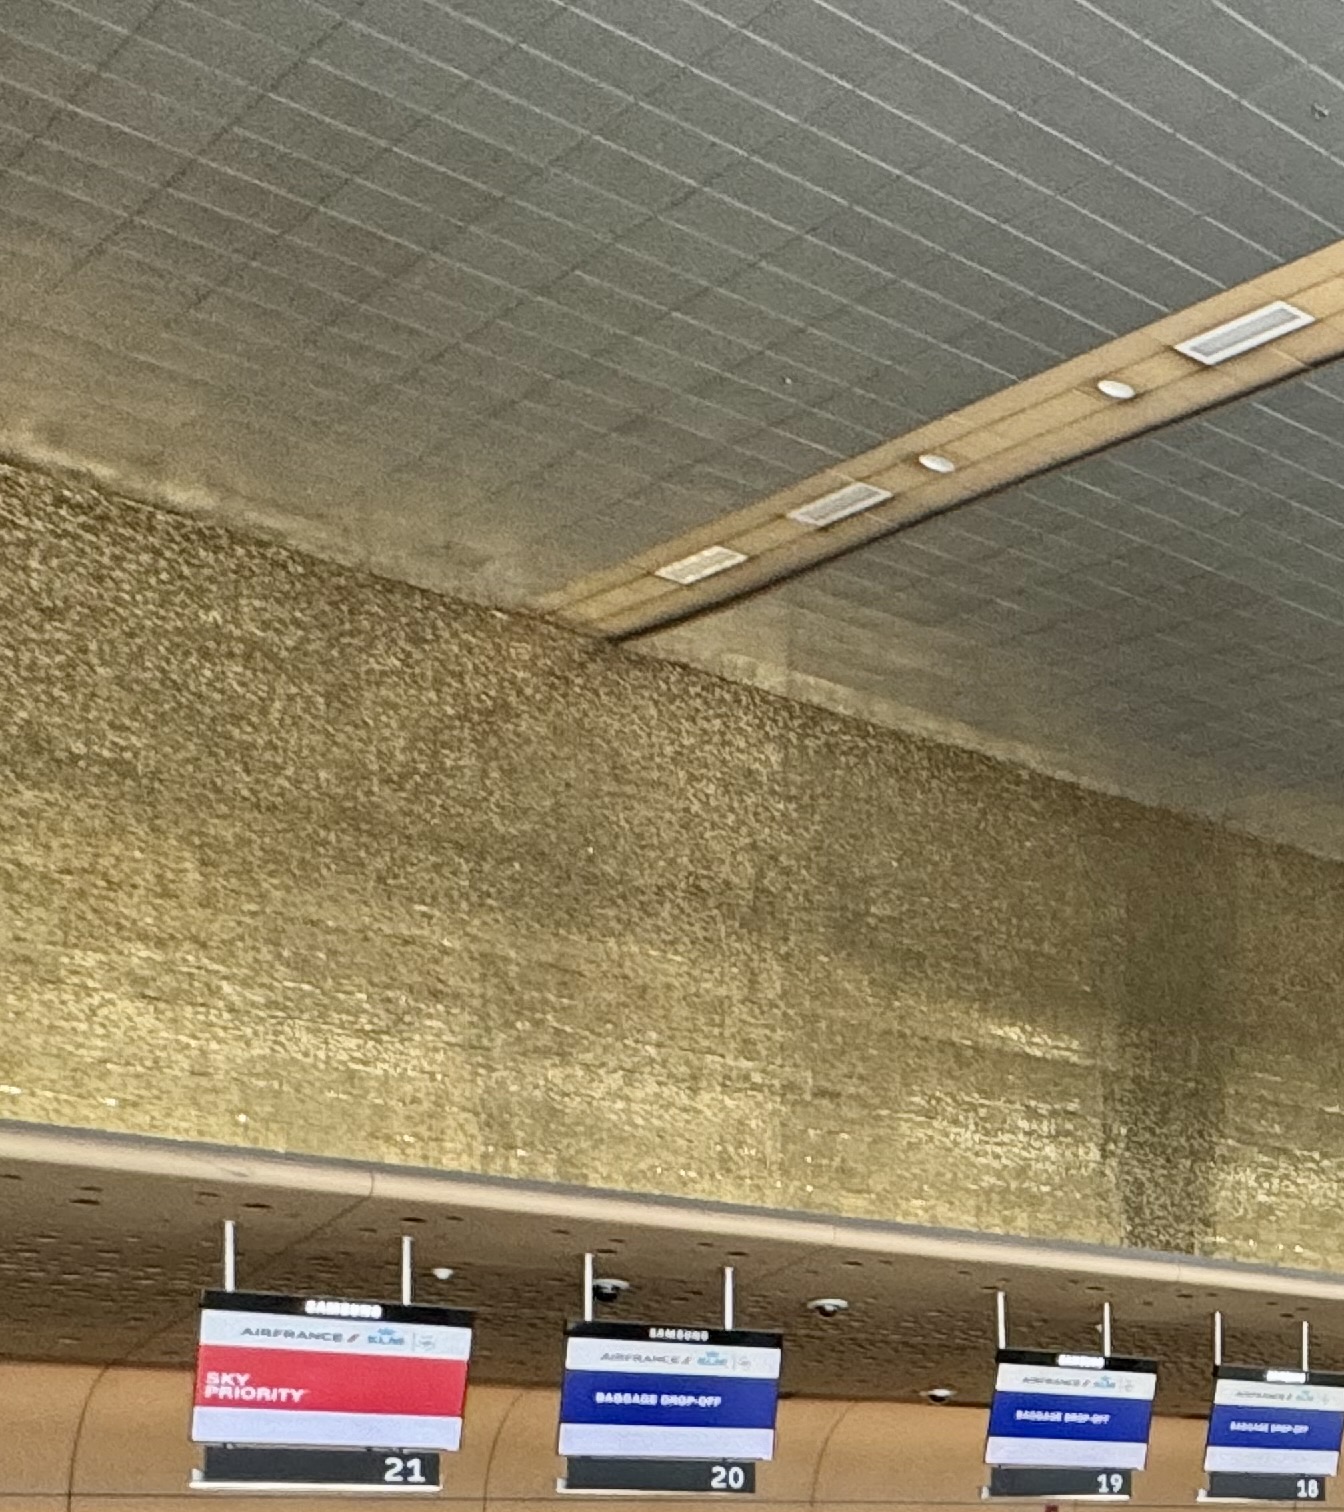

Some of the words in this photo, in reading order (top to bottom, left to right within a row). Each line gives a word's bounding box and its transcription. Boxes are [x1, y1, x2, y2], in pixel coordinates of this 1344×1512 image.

[240, 1327, 344, 1343] AIRFRANCE
[205, 1371, 250, 1386] SKY
[204, 1385, 304, 1404] PRIORITY
[384, 1457, 426, 1482] 21
[710, 1465, 745, 1489] 20
[1097, 1473, 1123, 1493] 19
[1295, 1479, 1319, 1498] 18
